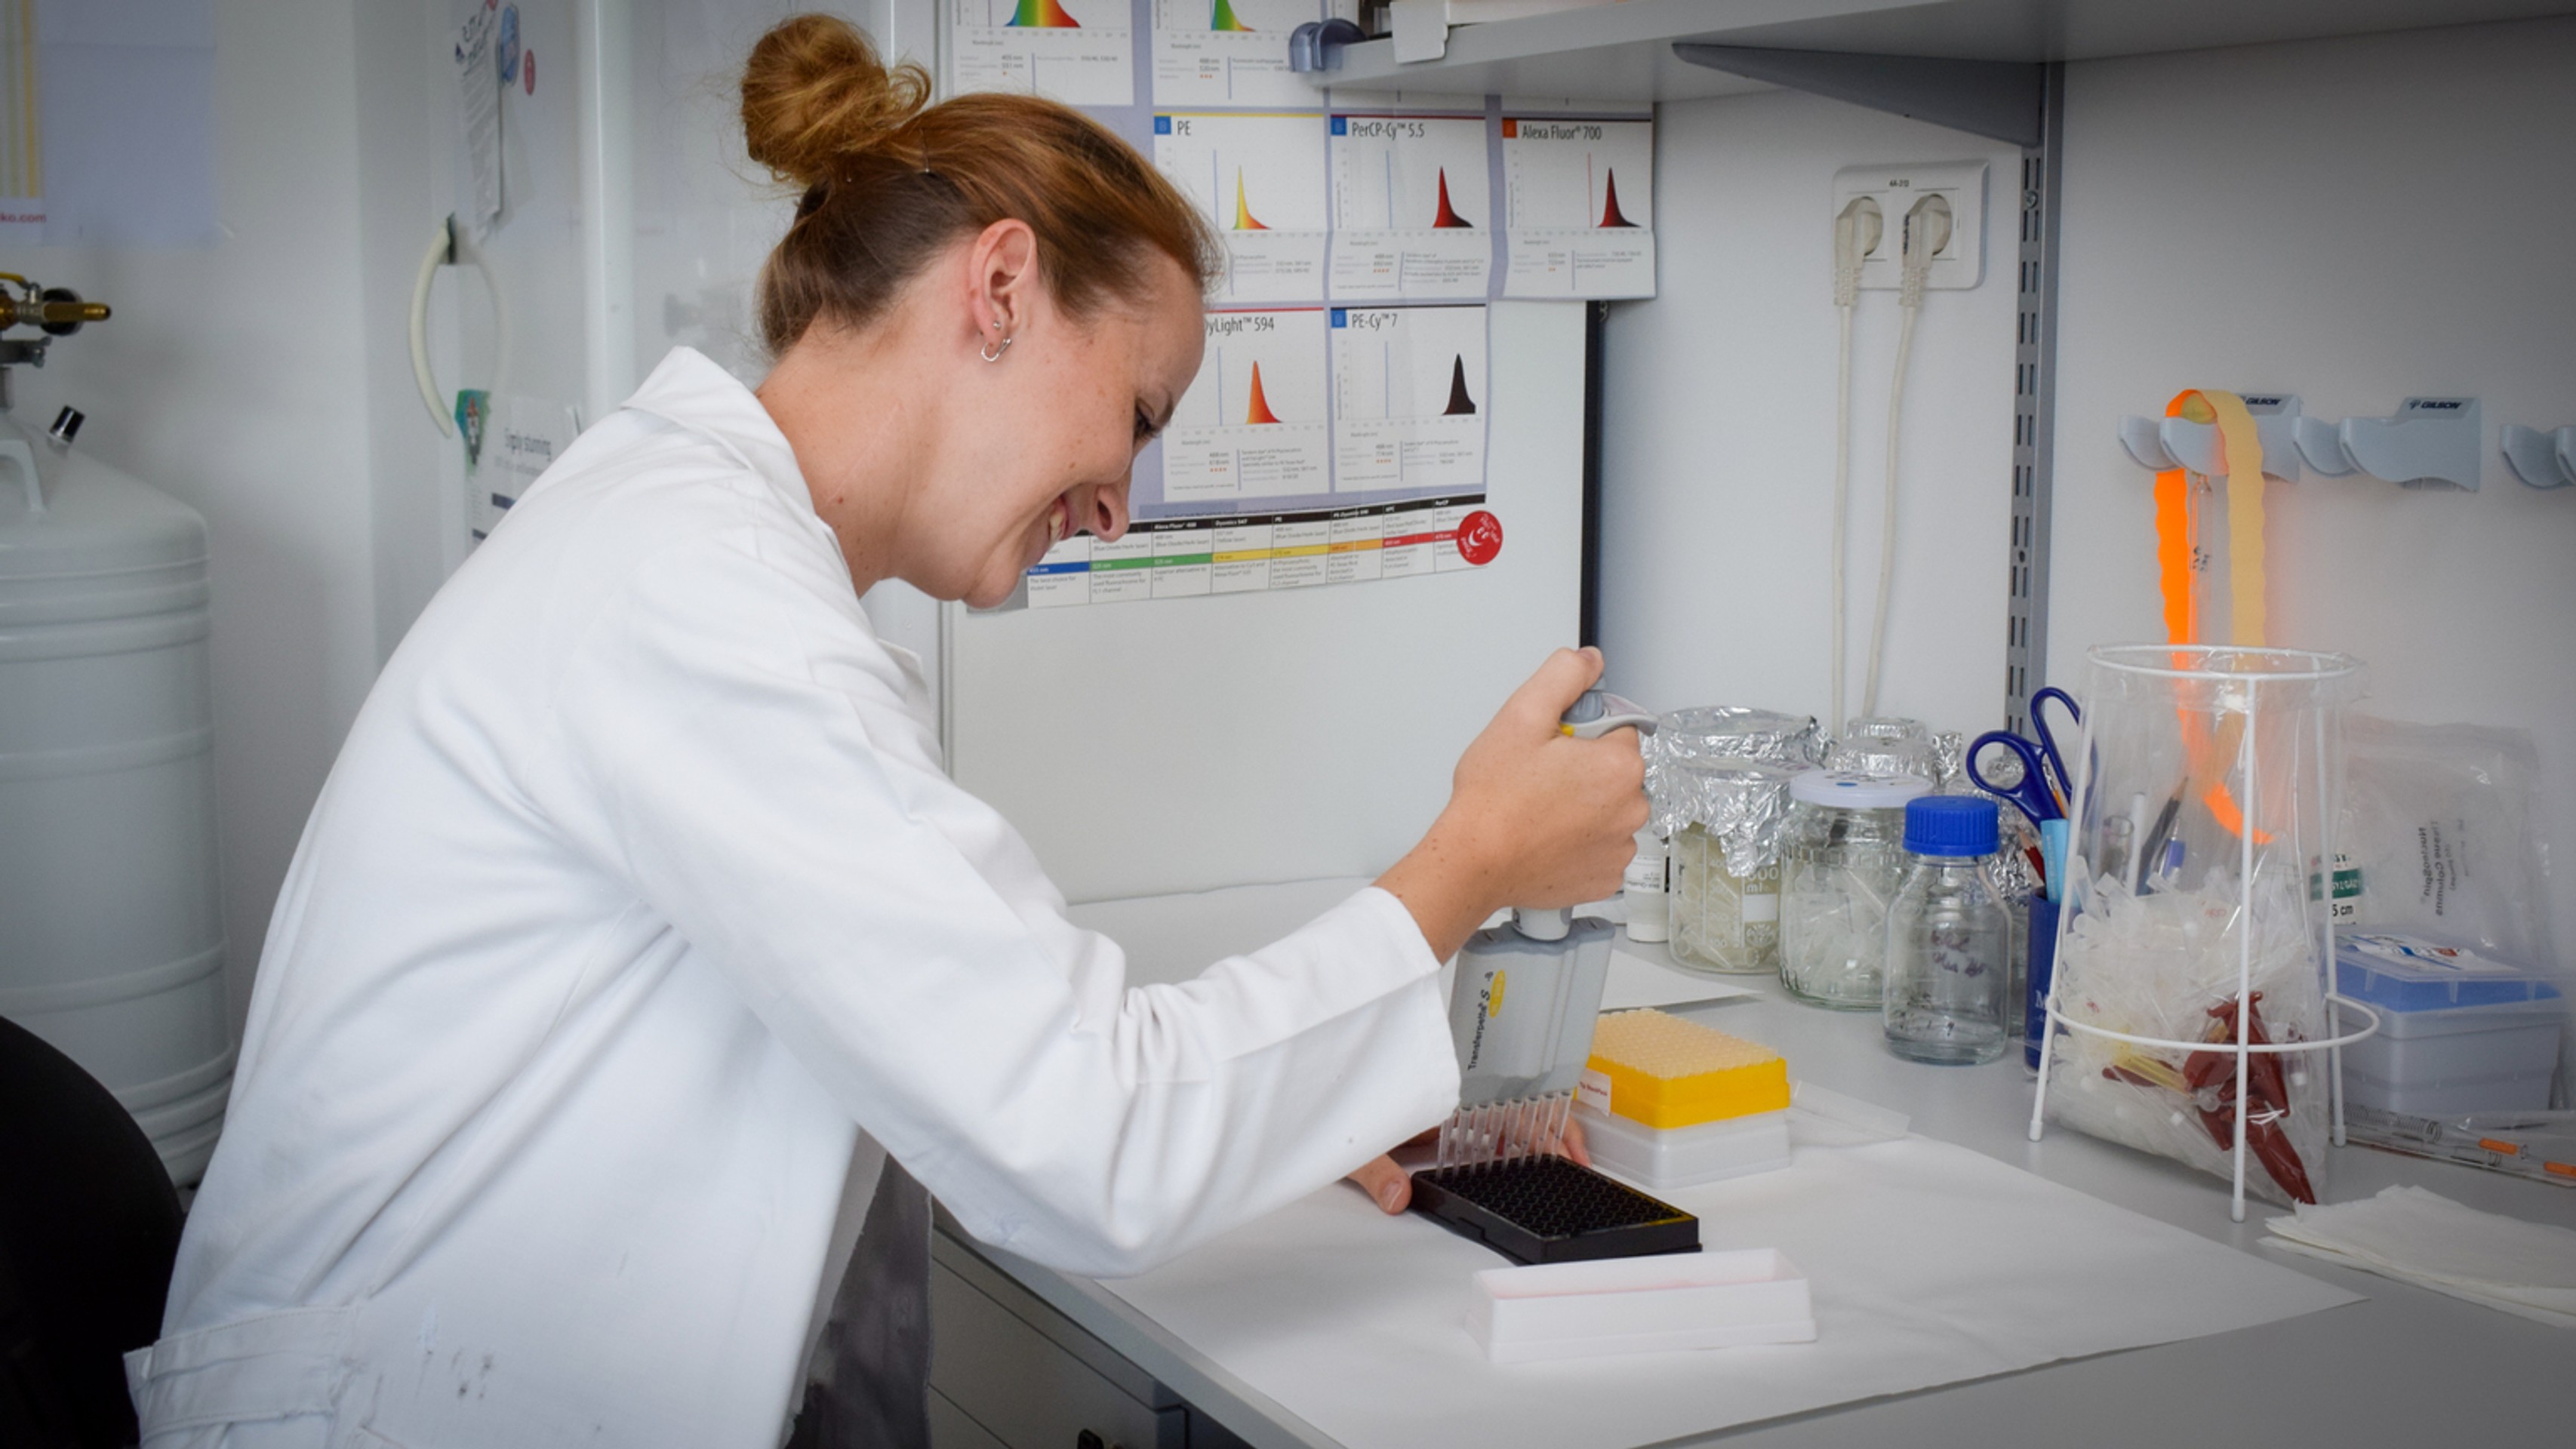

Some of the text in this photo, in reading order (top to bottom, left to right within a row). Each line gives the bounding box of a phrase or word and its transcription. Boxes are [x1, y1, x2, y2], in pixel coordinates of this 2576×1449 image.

[1177, 120, 1192, 136] PE
[1408, 122, 1425, 137] 5.5
[1522, 124, 1549, 140] Alexa
[1583, 125, 1602, 140] 700
[0, 212, 47, 223] ko.com
[1254, 316, 1274, 331] 594
[1391, 312, 1399, 328] 7
[2245, 396, 2281, 405] GILSON
[2421, 401, 2461, 409] GILSON
[1747, 882, 1762, 893] ml
[2340, 905, 2354, 916] cm
[1480, 989, 1491, 1001] S
